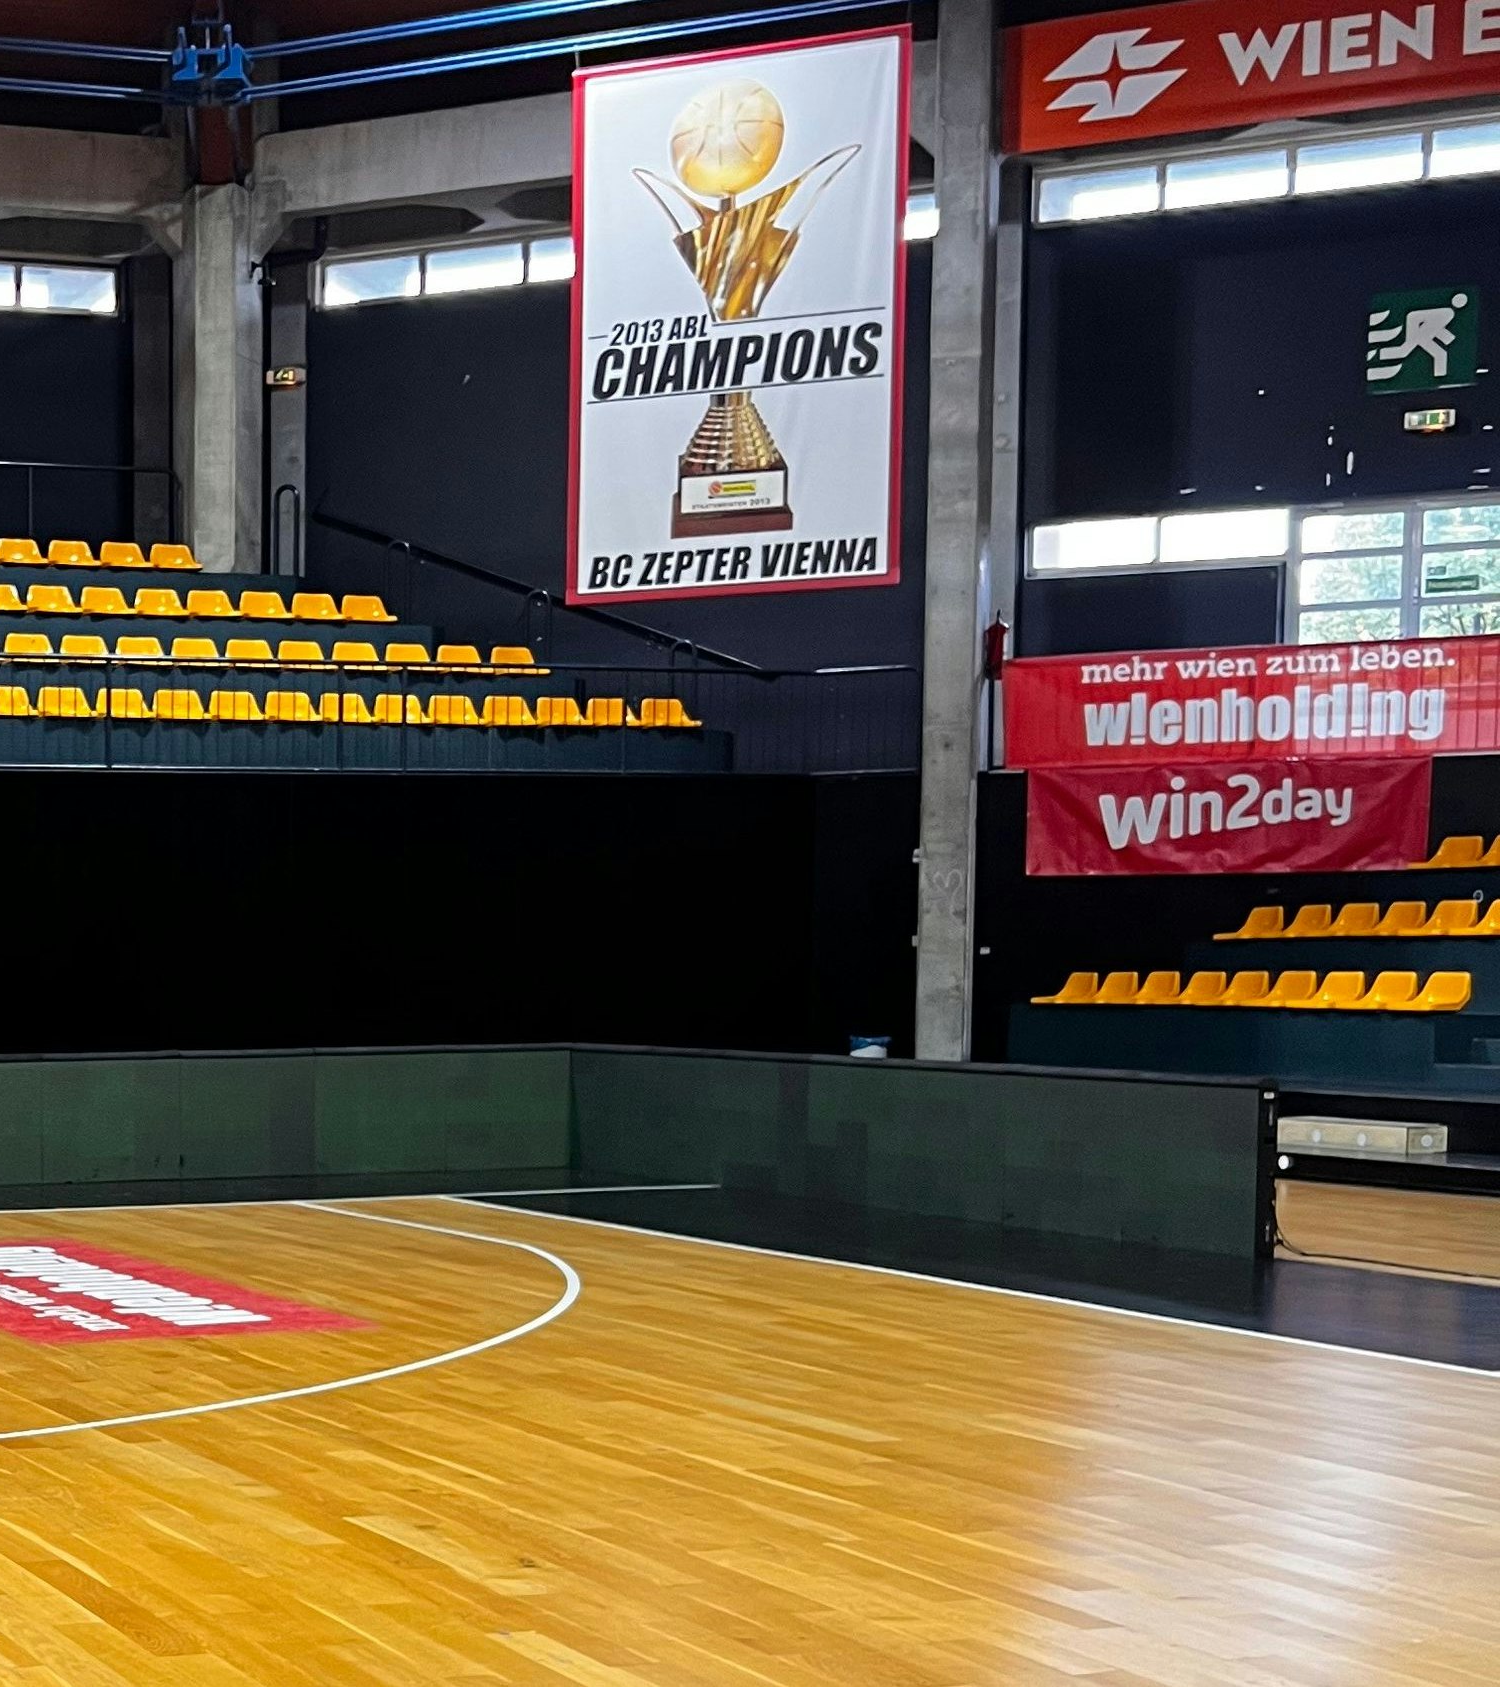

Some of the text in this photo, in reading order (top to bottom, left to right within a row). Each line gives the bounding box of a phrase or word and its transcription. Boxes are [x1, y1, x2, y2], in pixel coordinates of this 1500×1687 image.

[1218, 4, 1436, 87] WIEN
[592, 322, 883, 400] CHAMPIONS
[610, 314, 708, 346] 2013 ABL
[588, 537, 878, 589] BC ZEPTER VIENNA
[1081, 645, 1456, 684] mehr wien zum leben.
[1099, 774, 1353, 850] win2day
